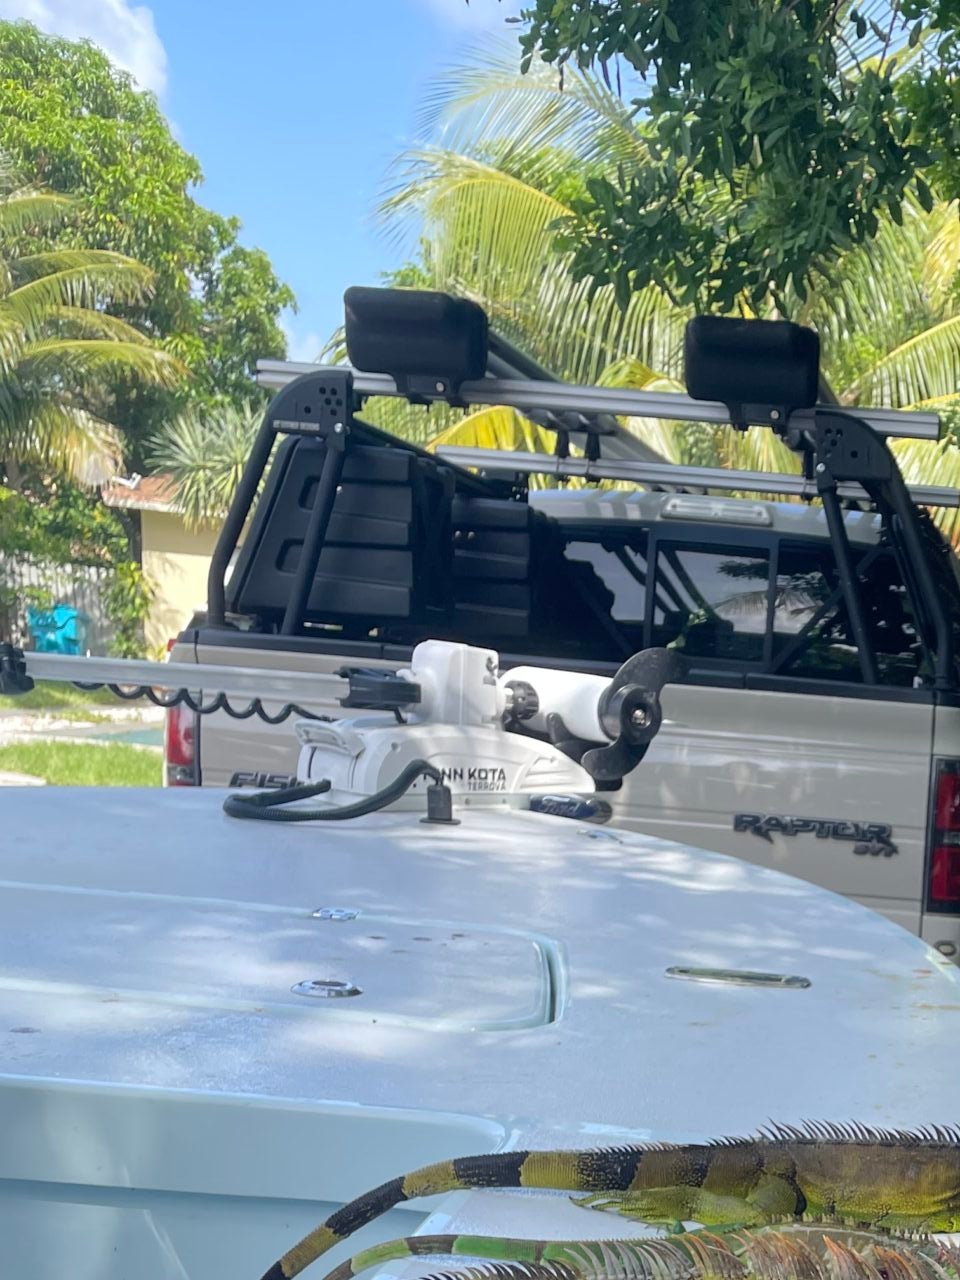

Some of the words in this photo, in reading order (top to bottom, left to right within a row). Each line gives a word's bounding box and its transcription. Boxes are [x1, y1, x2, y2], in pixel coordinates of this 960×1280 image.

[468, 767, 506, 781] KOTA
[468, 781, 507, 792] TERROVA
[733, 812, 898, 850] RAPTOR
